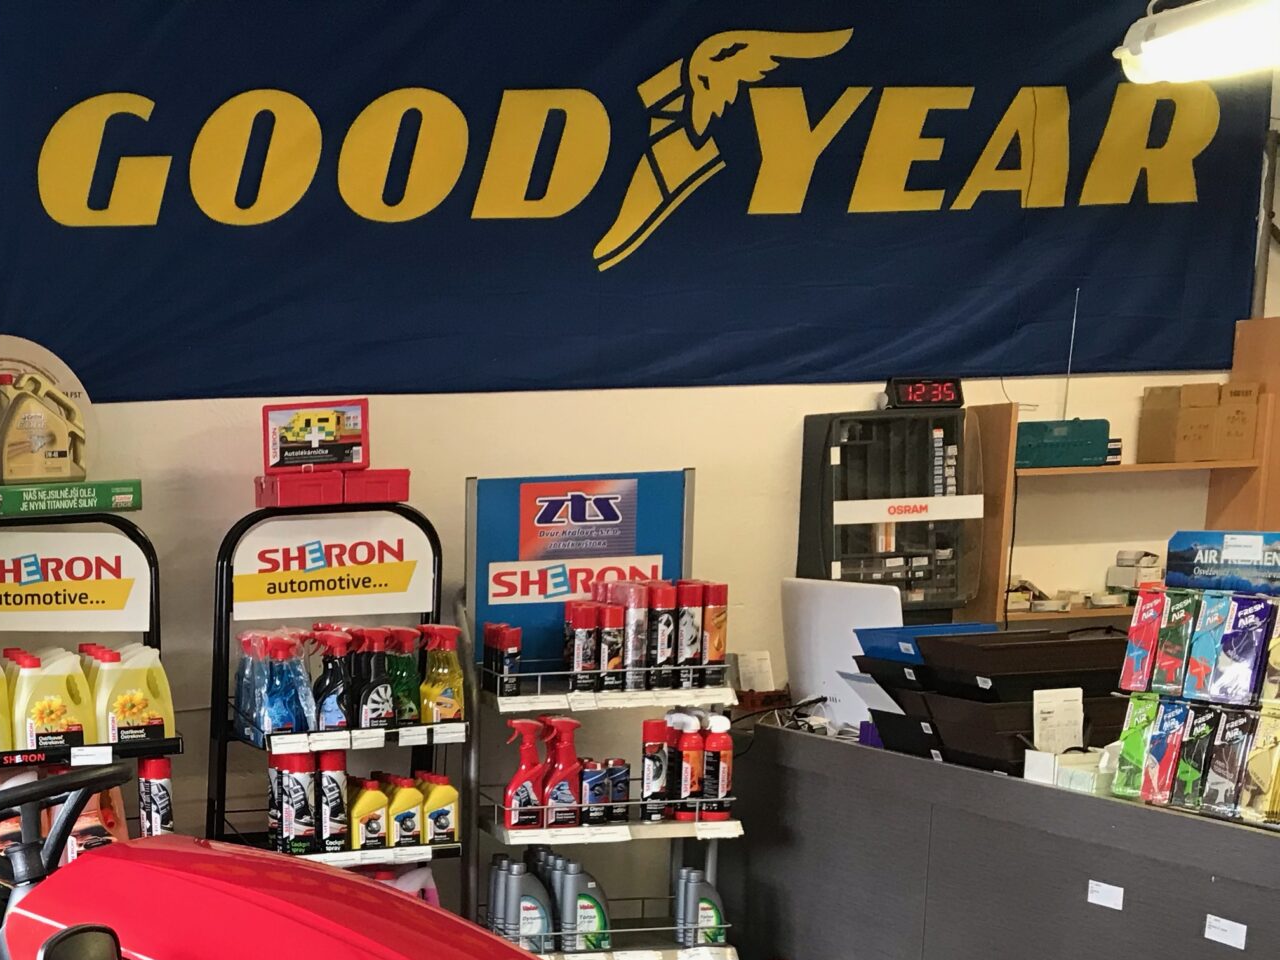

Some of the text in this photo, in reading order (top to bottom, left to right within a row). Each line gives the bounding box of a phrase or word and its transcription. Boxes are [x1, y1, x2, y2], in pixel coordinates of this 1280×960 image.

[79, 487, 96, 498] OLEJ
[20, 501, 28, 512] JE
[887, 504, 929, 516] OSRAM
[257, 538, 404, 574] SHERON
[1193, 549, 1218, 564] AIR
[267, 574, 388, 594] automotive...
[1171, 598, 1192, 612] FRESH
[1237, 602, 1265, 618] FRESH
[1171, 609, 1186, 623] AIR
[1238, 614, 1256, 628] AIR
[1163, 707, 1184, 720] FRESH
[1193, 712, 1214, 725] FRESH
[1225, 716, 1247, 730] FRESH
[3, 753, 46, 765] SHERON
[643, 764, 652, 793] SHERON
[681, 766, 690, 794] SHERON
[290, 841, 310, 849] Cockpit
[325, 839, 345, 848] Cockpit
